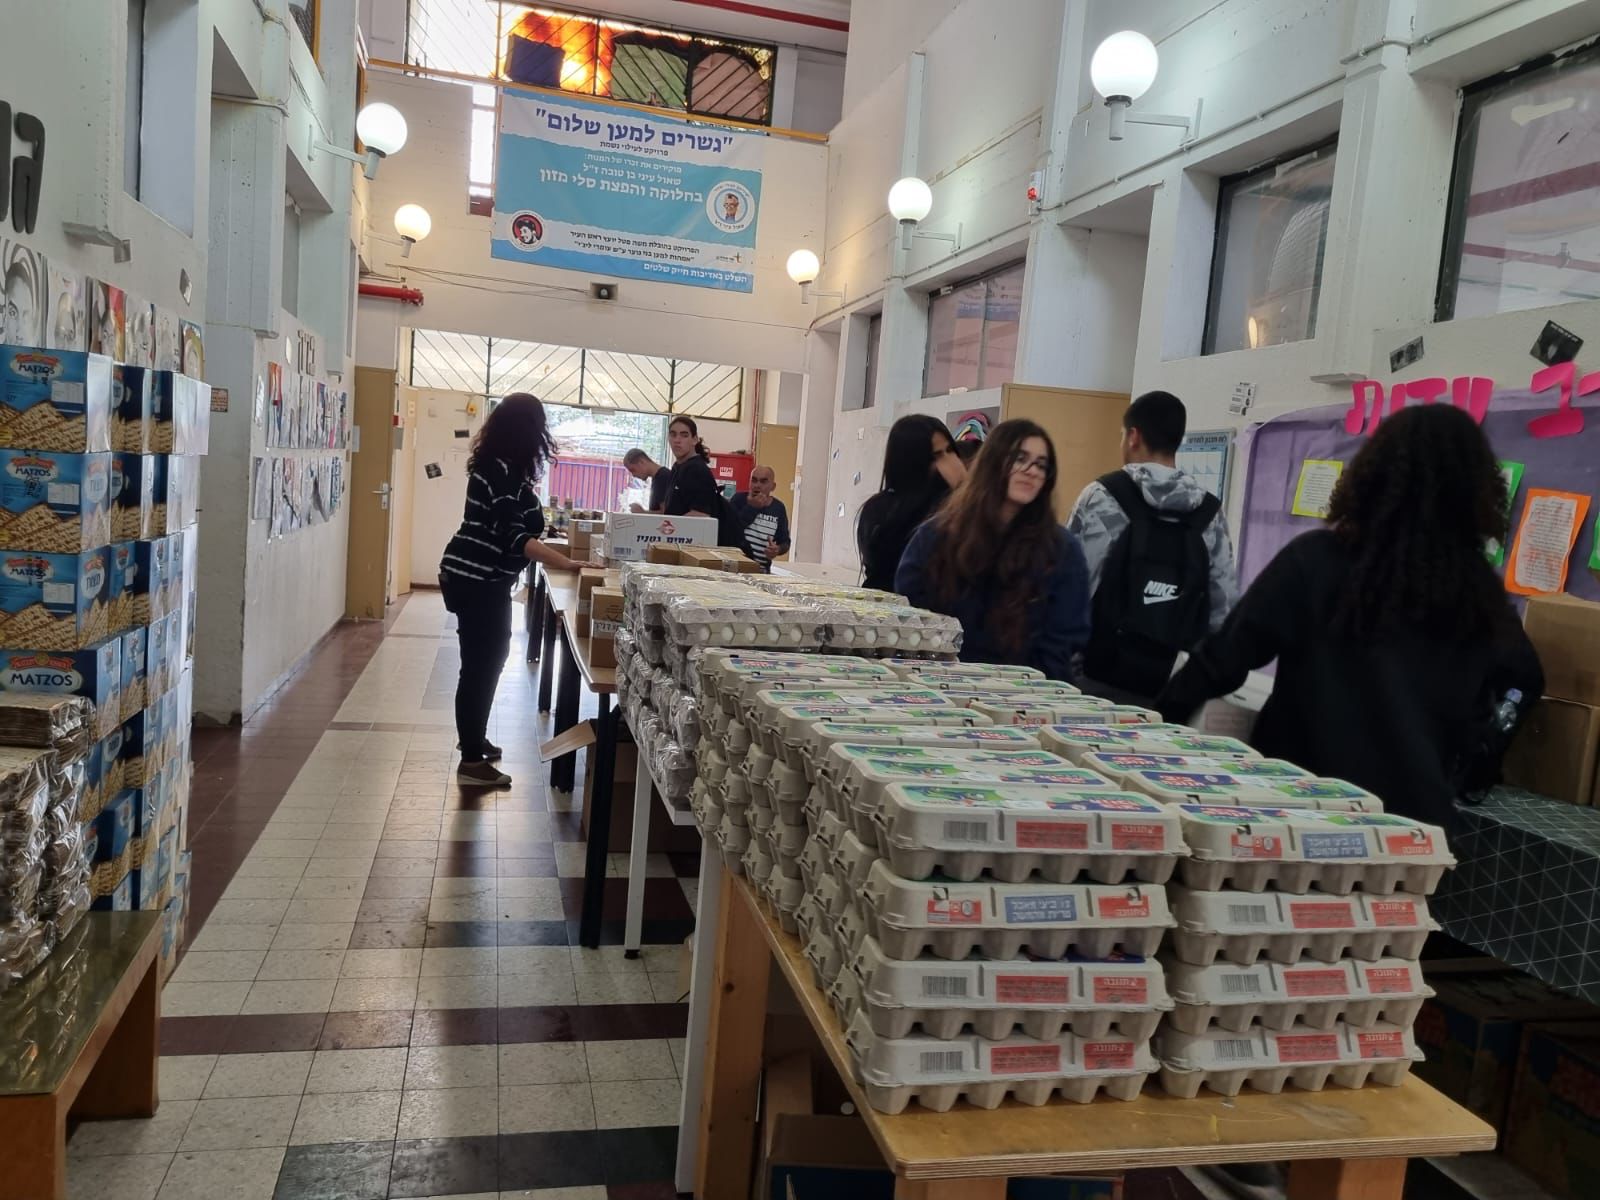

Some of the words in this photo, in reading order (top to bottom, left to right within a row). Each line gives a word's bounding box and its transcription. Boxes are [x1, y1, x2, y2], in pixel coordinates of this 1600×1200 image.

[536, 107, 601, 136] שלום"
[607, 121, 655, 143] למען
[600, 141, 620, 149] נשמת
[621, 143, 643, 153] לעילוי
[661, 131, 733, 153] "גשרים
[611, 155, 622, 163] של
[539, 167, 568, 183] מזון
[601, 166, 625, 177] טובה
[627, 170, 636, 179] בן
[572, 172, 597, 189] סלי
[657, 174, 681, 186] שאול
[599, 179, 646, 196] והפצת
[650, 186, 704, 203] בחלוקה
[587, 232, 602, 241] ראש
[643, 262, 670, 273] שלטים
[690, 269, 723, 281] באדיבות
[724, 272, 747, 283] השלט
[18, 363, 55, 375] MATZOS
[15, 466, 51, 477] MATZOS
[666, 536, 693, 545] אחים
[1144, 580, 1179, 597] NIKE
[10, 673, 73, 686] MATZOS
